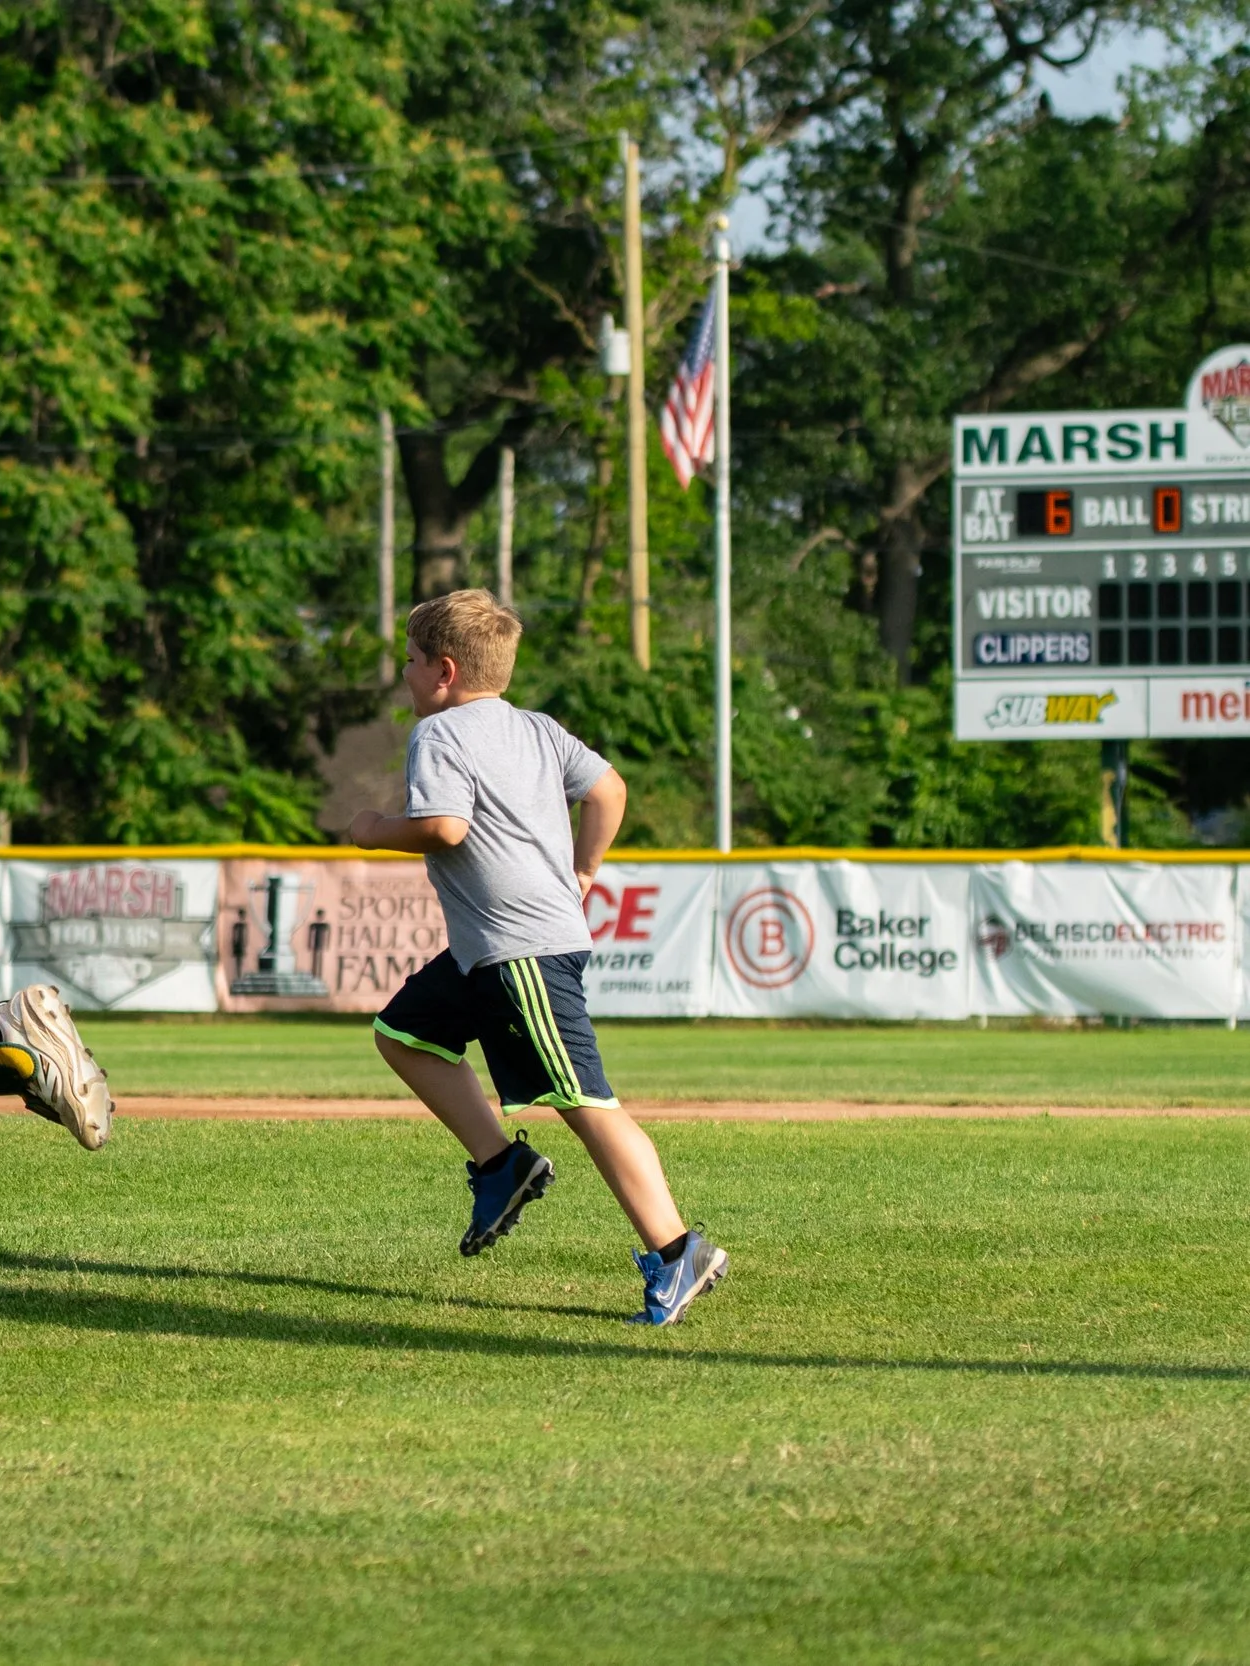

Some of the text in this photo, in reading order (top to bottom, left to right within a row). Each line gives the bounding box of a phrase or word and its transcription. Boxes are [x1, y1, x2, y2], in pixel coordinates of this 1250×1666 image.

[962, 421, 1187, 465] MARSH
[974, 488, 1005, 516] AT
[1045, 490, 1071, 535] 6
[1082, 496, 1150, 527] BALL
[1154, 487, 1181, 533] 0
[1190, 492, 1250, 525] STRI
[964, 514, 1014, 542] BAT
[1103, 552, 1237, 578] 1 2 3 4 5
[977, 586, 1092, 619] VISITOR
[979, 634, 1090, 664] CLIPPERS
[985, 689, 1118, 729] SUBWAY
[46, 865, 175, 918] MARSH
[337, 925, 407, 950] HALL
[836, 909, 930, 938] Baker
[336, 955, 431, 993] FAM
[833, 941, 958, 978] College
[599, 979, 694, 994] SPRING LAKE
